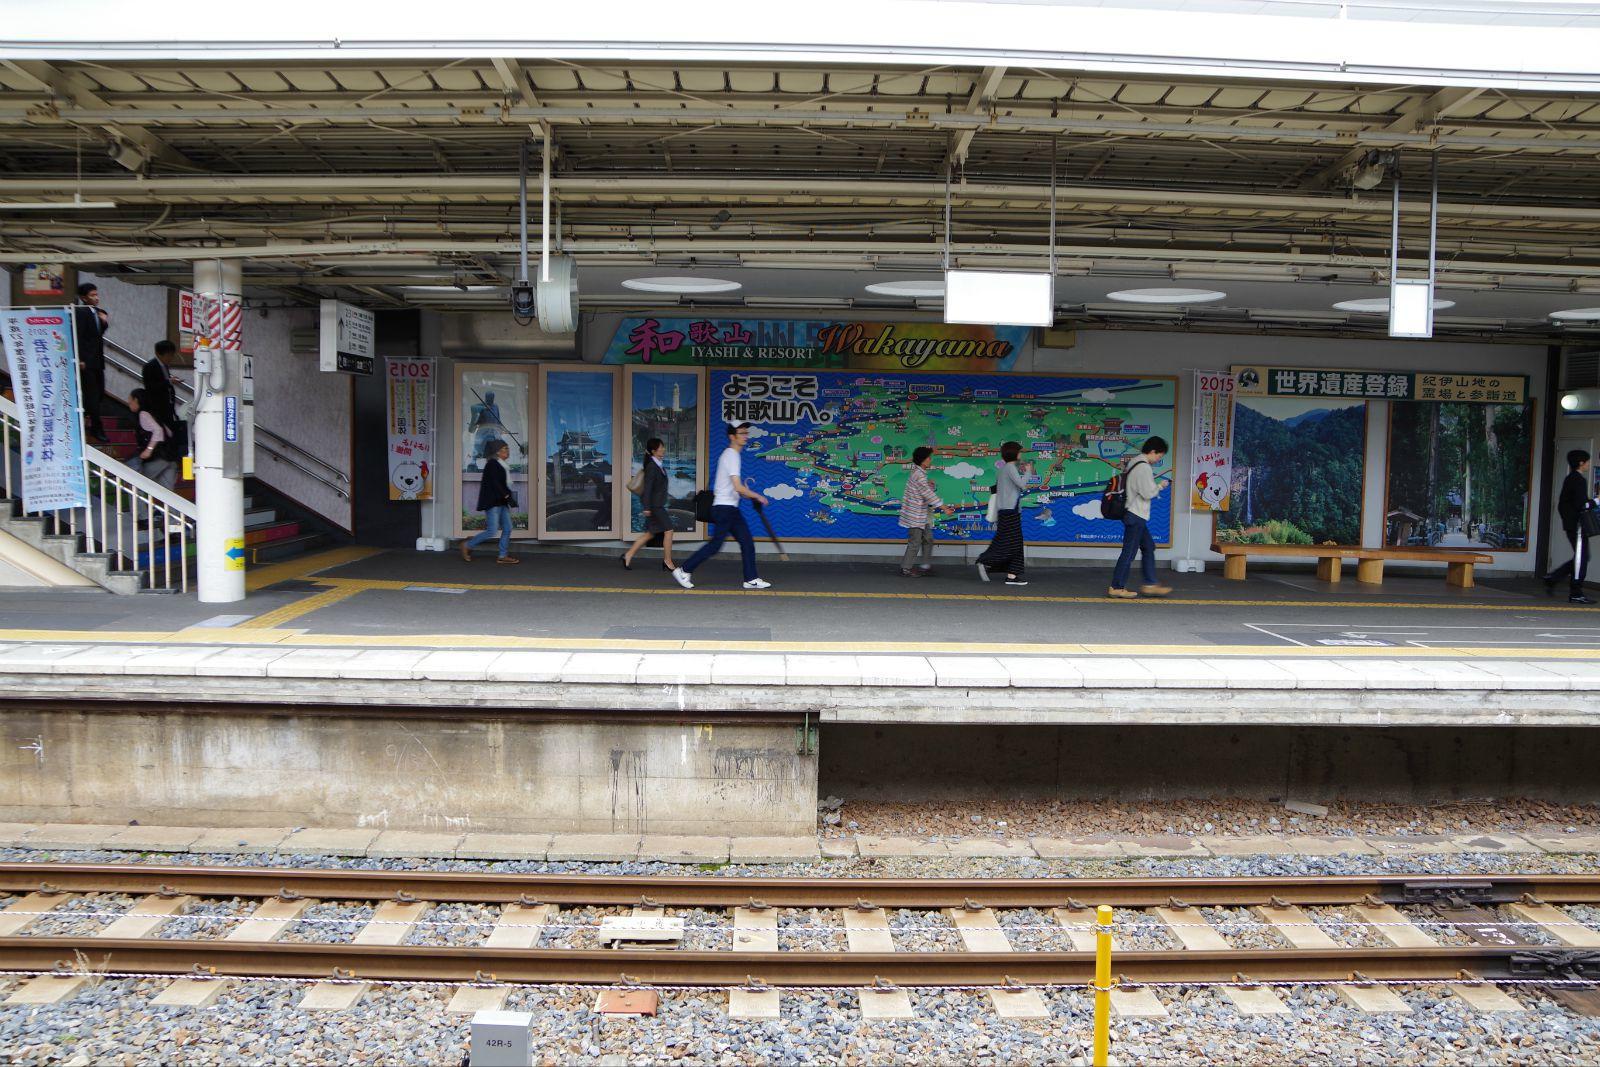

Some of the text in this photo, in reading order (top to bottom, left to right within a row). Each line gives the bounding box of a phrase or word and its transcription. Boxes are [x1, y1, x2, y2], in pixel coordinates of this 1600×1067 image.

[625, 318, 754, 363] 和歌山
[817, 324, 1013, 368] Wakayama
[690, 345, 816, 360] IYASHI & RESORT
[723, 375, 818, 398] ようこそ
[1200, 376, 1234, 392] 2015
[1275, 370, 1409, 397] 世界遺産登録
[1422, 375, 1500, 389] 紀伊山地の
[1423, 388, 1518, 402] 霊場と参詣道
[723, 399, 832, 424] 和歌山へ。
[486, 1039, 512, 1048] 42R-5
